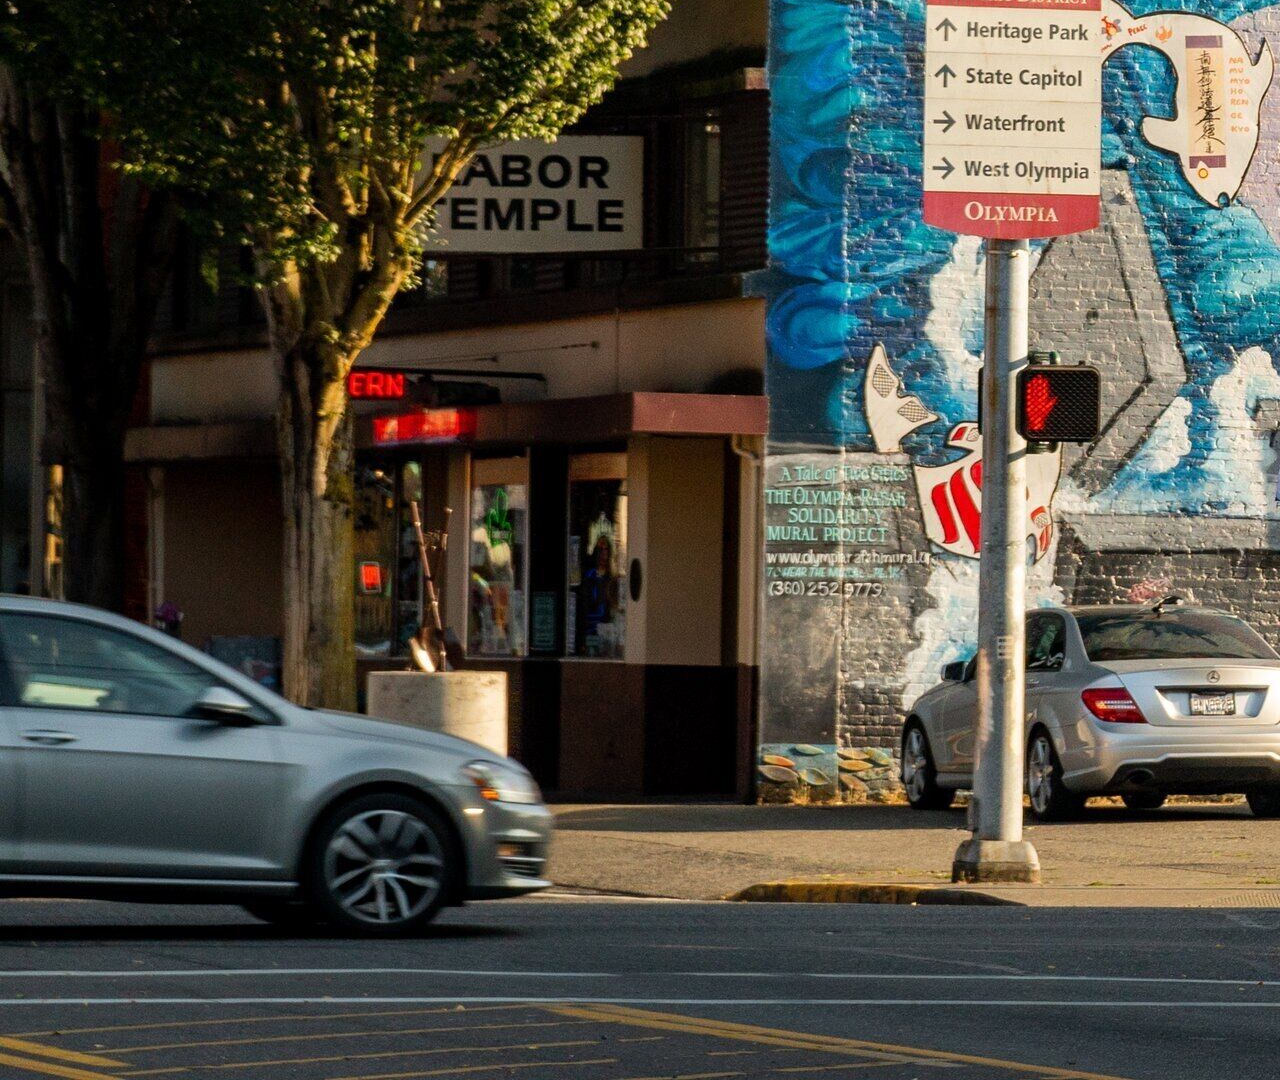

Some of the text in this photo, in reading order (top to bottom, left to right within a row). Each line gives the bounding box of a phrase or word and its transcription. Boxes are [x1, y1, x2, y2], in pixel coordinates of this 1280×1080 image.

[967, 21, 1089, 43] Heritage Park
[966, 67, 1082, 90] State Capitol
[965, 114, 1066, 133] Waterfront
[964, 160, 1090, 183] West Olympia
[779, 466, 792, 482] A
[794, 465, 820, 481] Tale
[824, 466, 837, 484] of
[842, 464, 869, 481] Two
[765, 488, 791, 505] THE
[789, 507, 885, 525] SOLIDARITY
[767, 525, 889, 542] MURAL PROJECT
[768, 580, 805, 597] (360)
